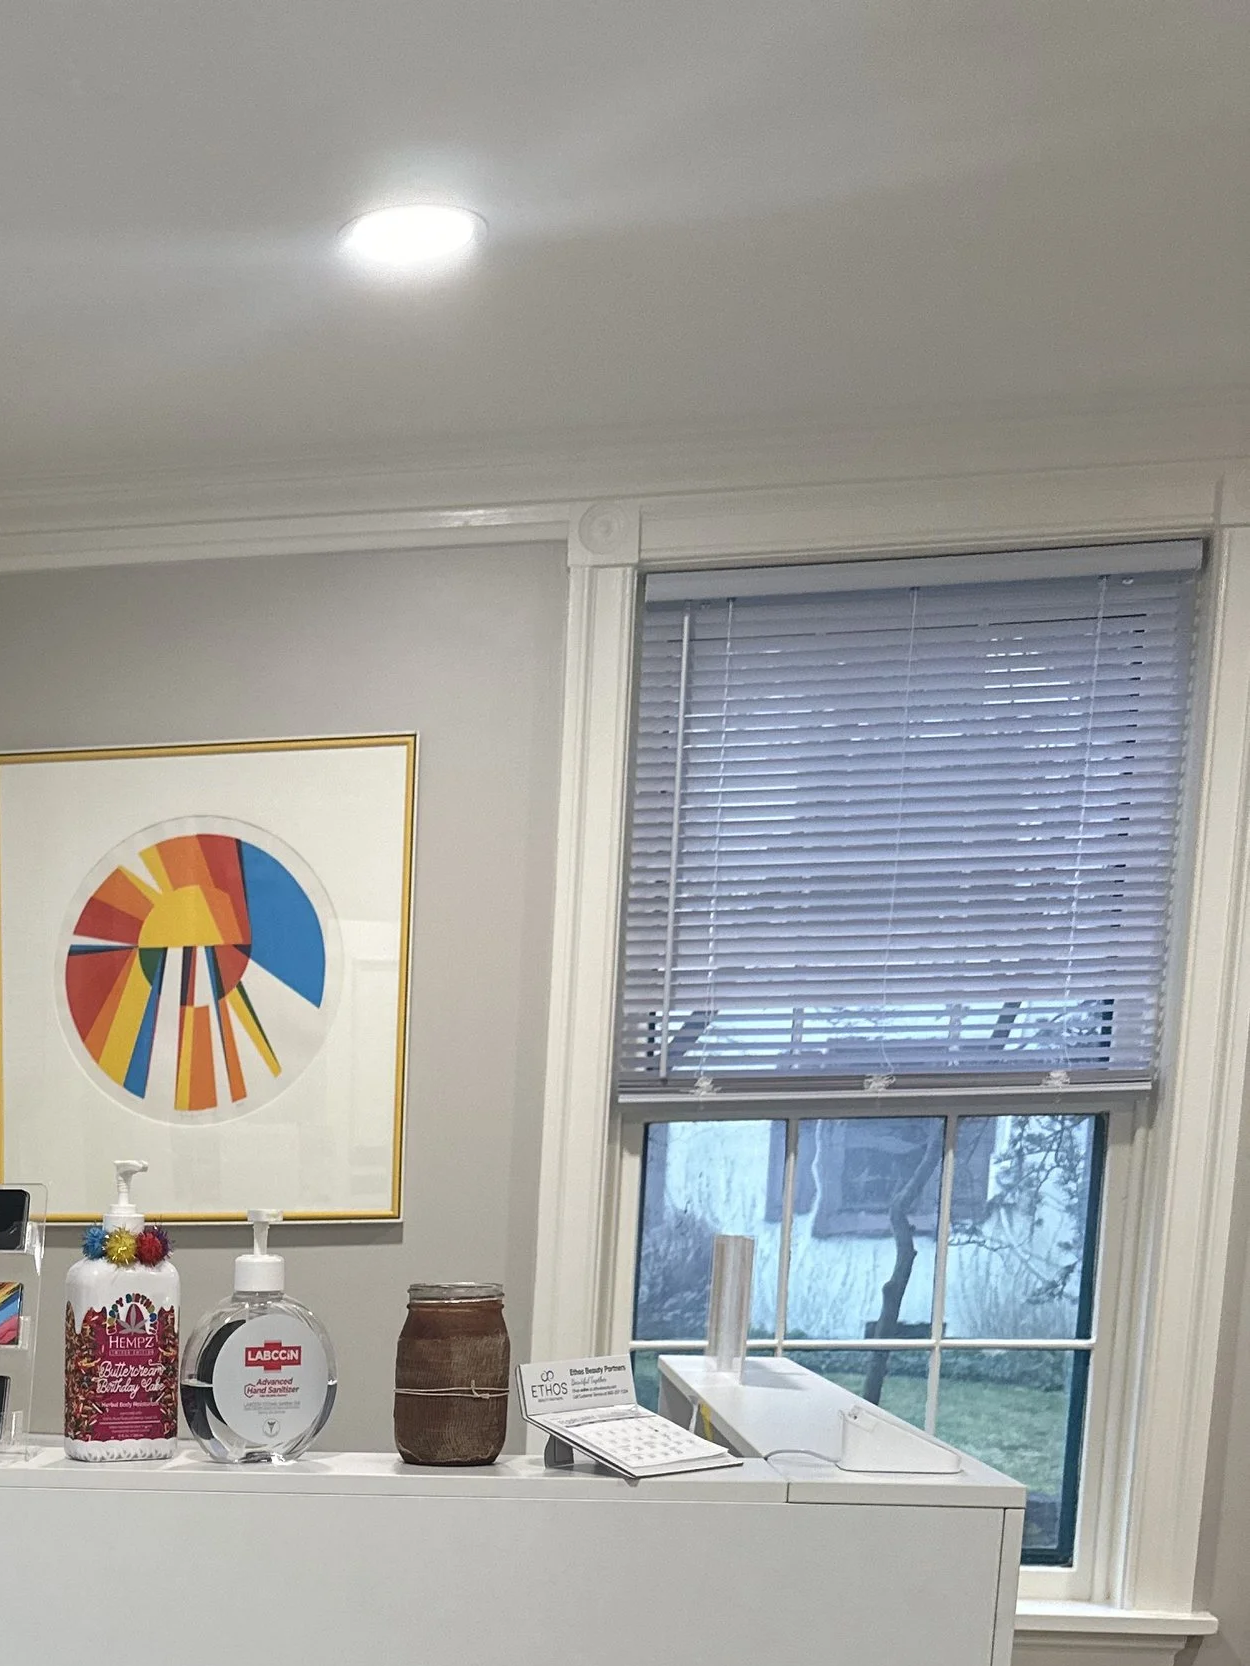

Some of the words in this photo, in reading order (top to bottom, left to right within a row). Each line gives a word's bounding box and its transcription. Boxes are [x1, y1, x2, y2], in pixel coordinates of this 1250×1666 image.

[109, 1336, 155, 1349] HEMPZ
[99, 1359, 166, 1378] Buttercream
[585, 1367, 603, 1375] Beauty
[604, 1365, 627, 1373] Partners
[256, 1377, 294, 1386] Advanced
[96, 1377, 141, 1400] Birthday
[141, 1377, 166, 1393] Cake
[246, 1386, 266, 1395] Hand
[268, 1385, 300, 1394] Sanitizer
[531, 1382, 569, 1399] ETHOS
